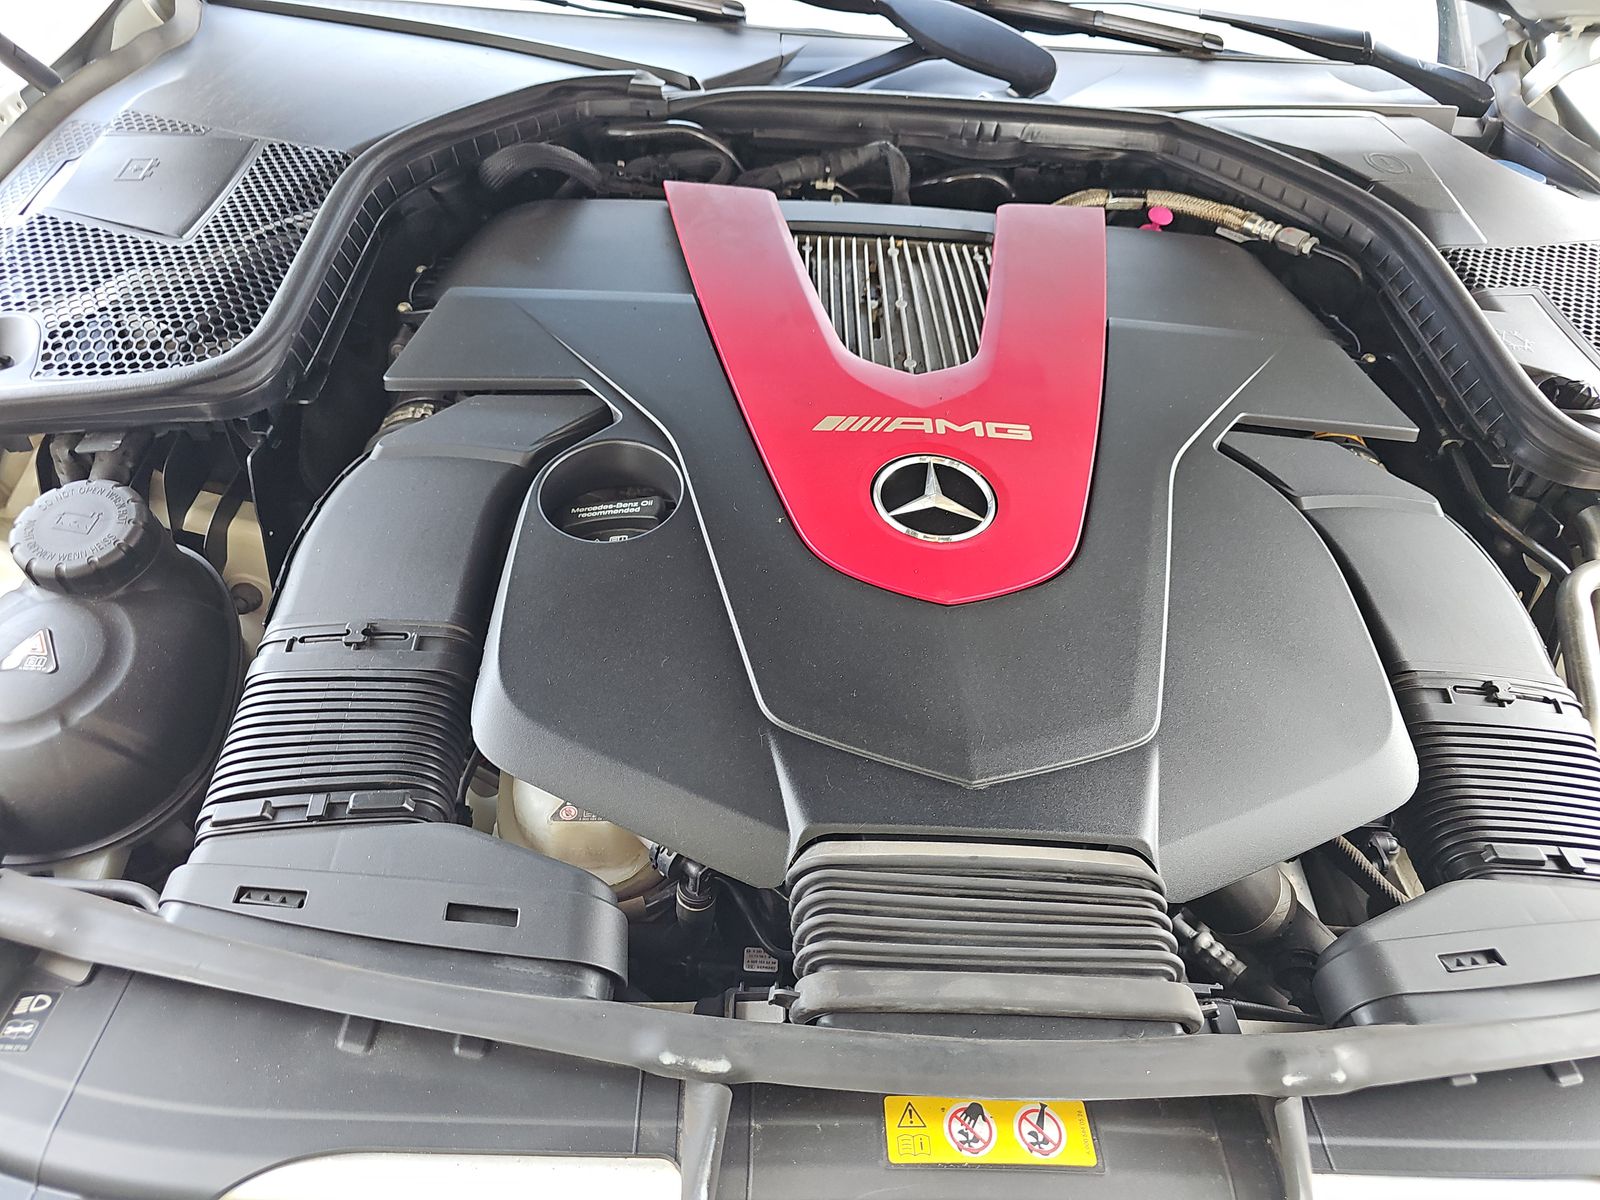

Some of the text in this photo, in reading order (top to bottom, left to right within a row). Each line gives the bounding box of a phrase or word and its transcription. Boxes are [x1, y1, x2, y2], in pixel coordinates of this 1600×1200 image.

[883, 416, 1033, 441] AMG
[79, 487, 106, 496] OPEN
[571, 499, 654, 514] Mercedes-Benz Oil
[577, 506, 641, 518] recommended
[58, 551, 88, 562] WENN
[90, 533, 117, 554] HEISS
